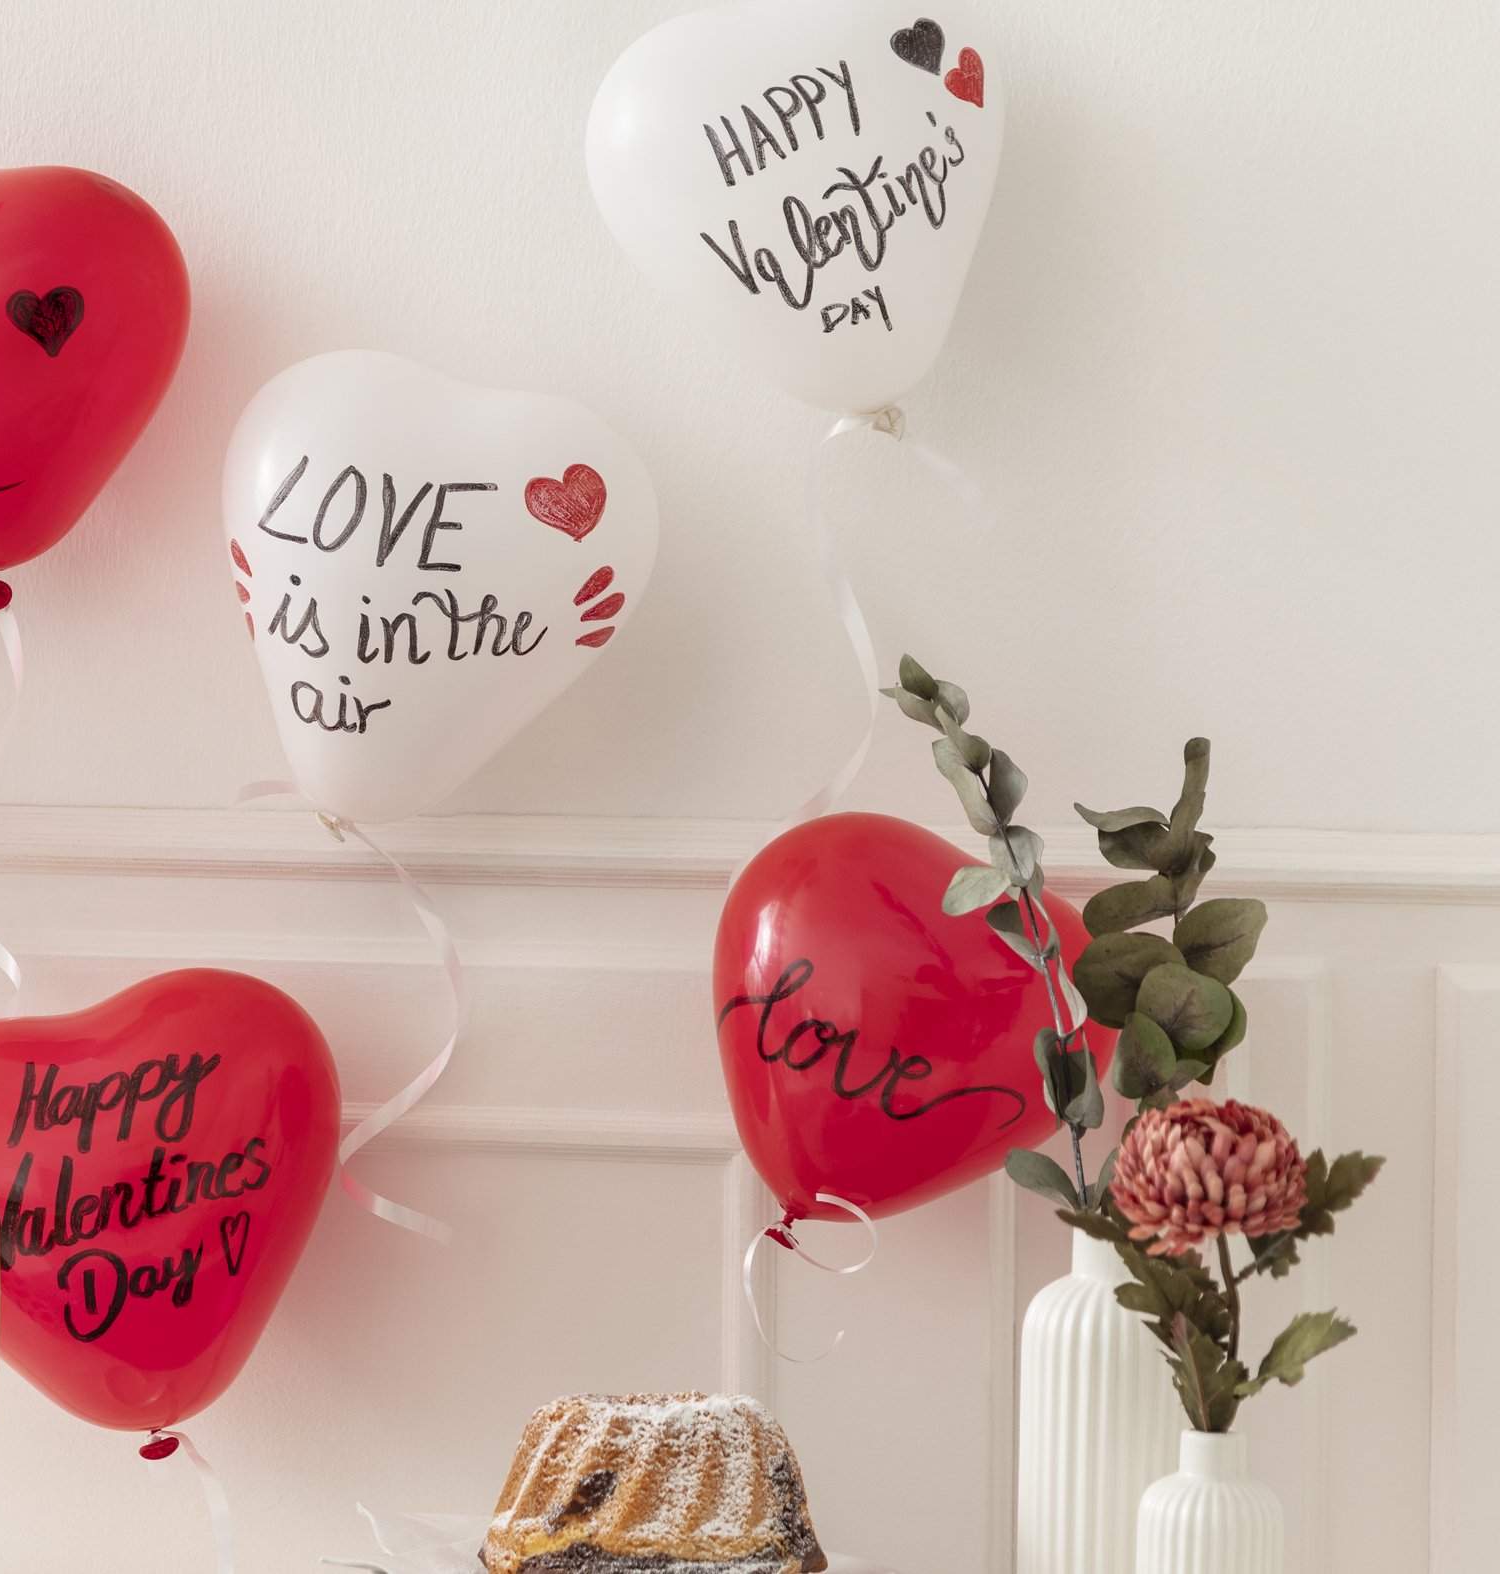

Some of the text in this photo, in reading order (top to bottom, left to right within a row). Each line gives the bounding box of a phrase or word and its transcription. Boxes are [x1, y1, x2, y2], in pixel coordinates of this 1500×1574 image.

[703, 59, 861, 187] HAPPY
[820, 285, 893, 334] DAY
[257, 454, 499, 572] LOVE
[267, 573, 330, 659] is
[290, 675, 392, 735] air
[6, 1051, 222, 1154] Happy
[56, 1238, 204, 1343] Day
